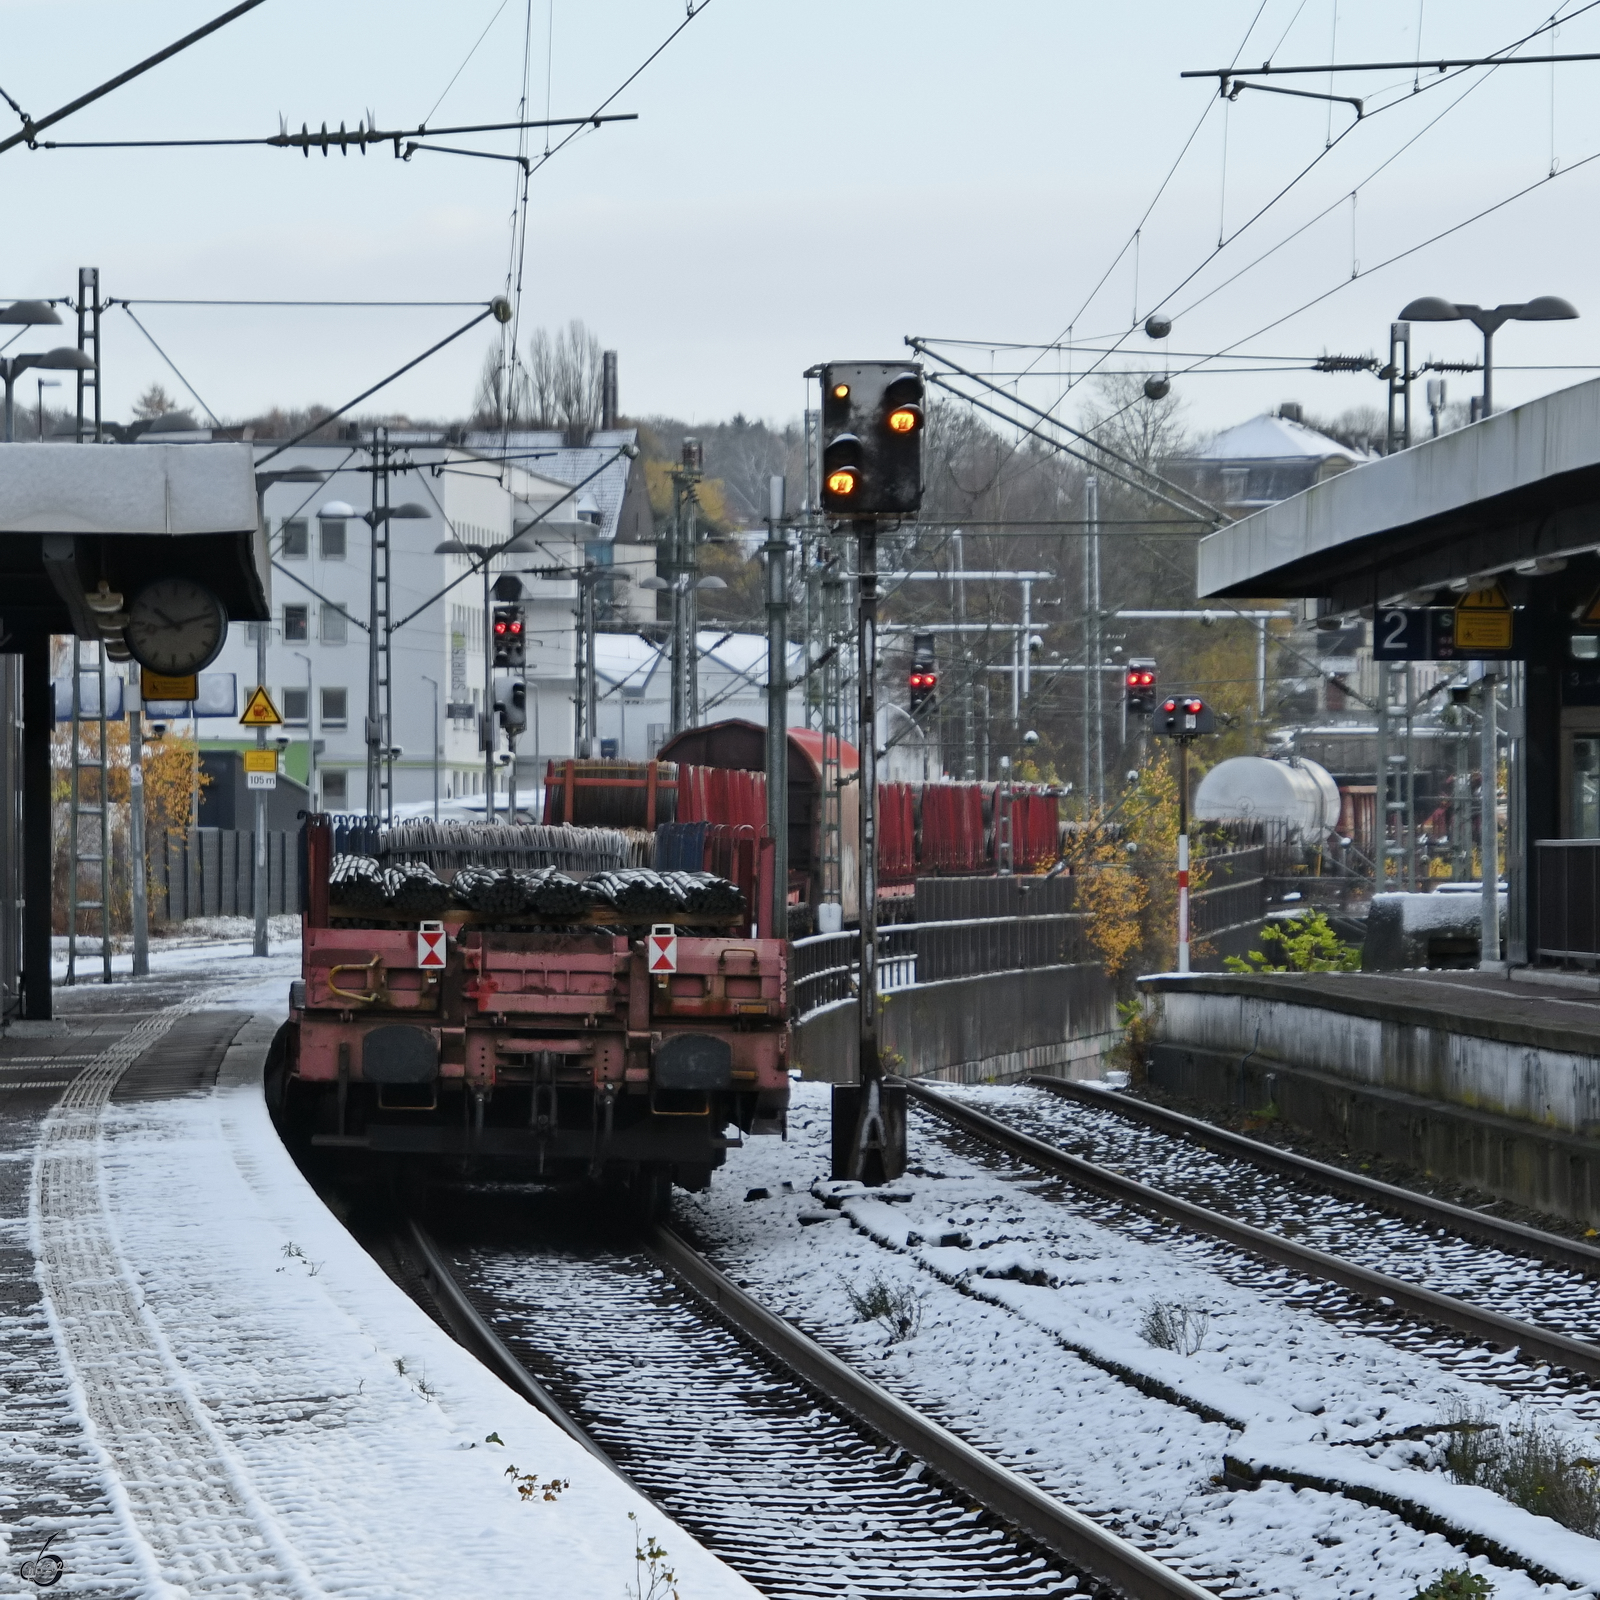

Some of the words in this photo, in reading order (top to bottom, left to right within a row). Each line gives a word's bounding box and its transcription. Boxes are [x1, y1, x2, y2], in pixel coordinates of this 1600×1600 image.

[1384, 611, 1408, 648] 2
[250, 775, 264, 785] 105
[266, 777, 275, 785] m
